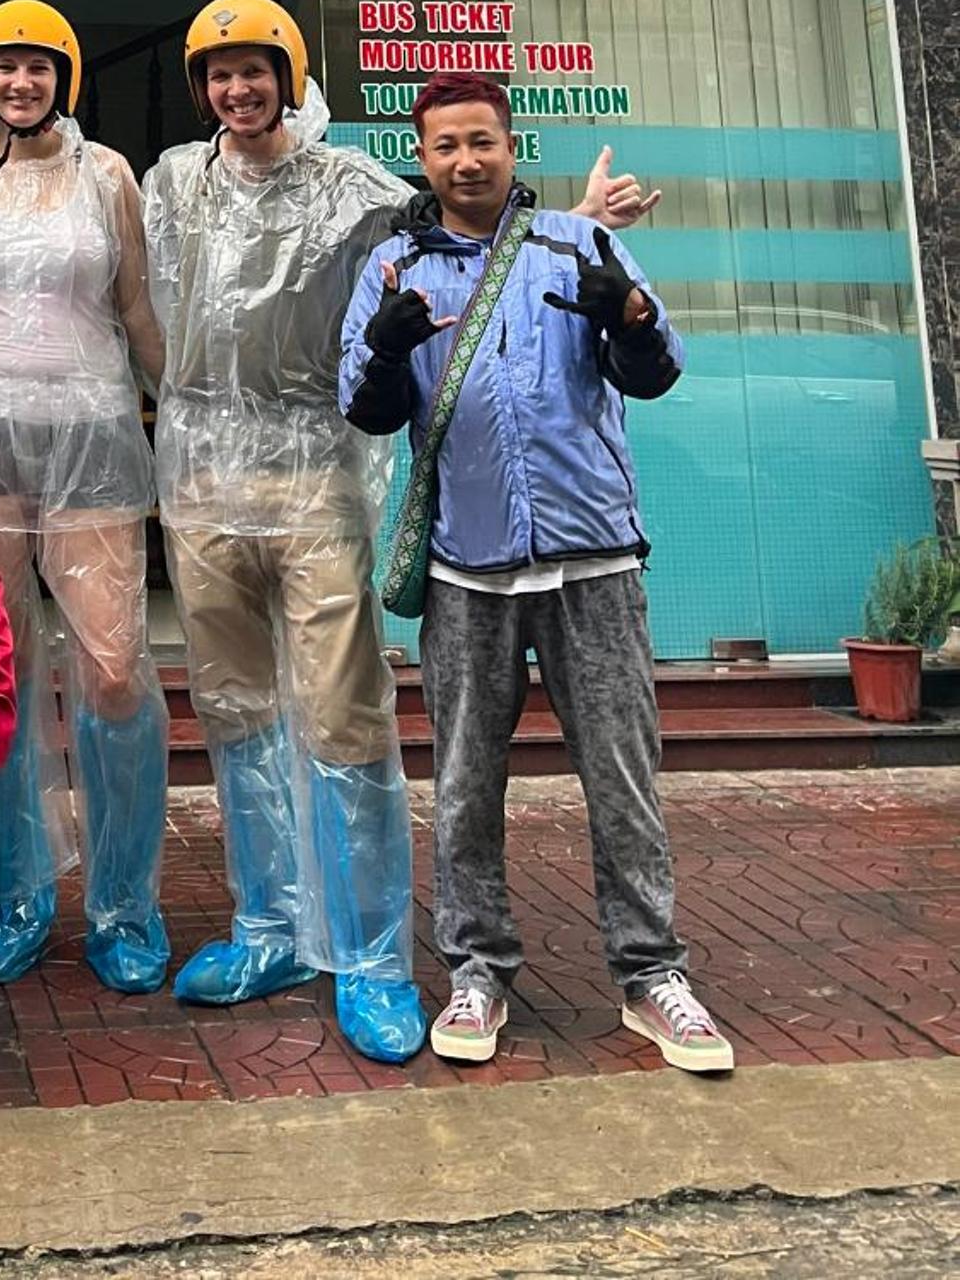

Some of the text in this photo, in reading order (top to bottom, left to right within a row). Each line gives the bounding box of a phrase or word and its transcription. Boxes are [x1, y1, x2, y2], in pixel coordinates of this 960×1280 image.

[359, 1, 515, 32] BUS TICKET
[359, 40, 595, 73] MOTORBIKE TOUR
[361, 83, 430, 116] TOU
